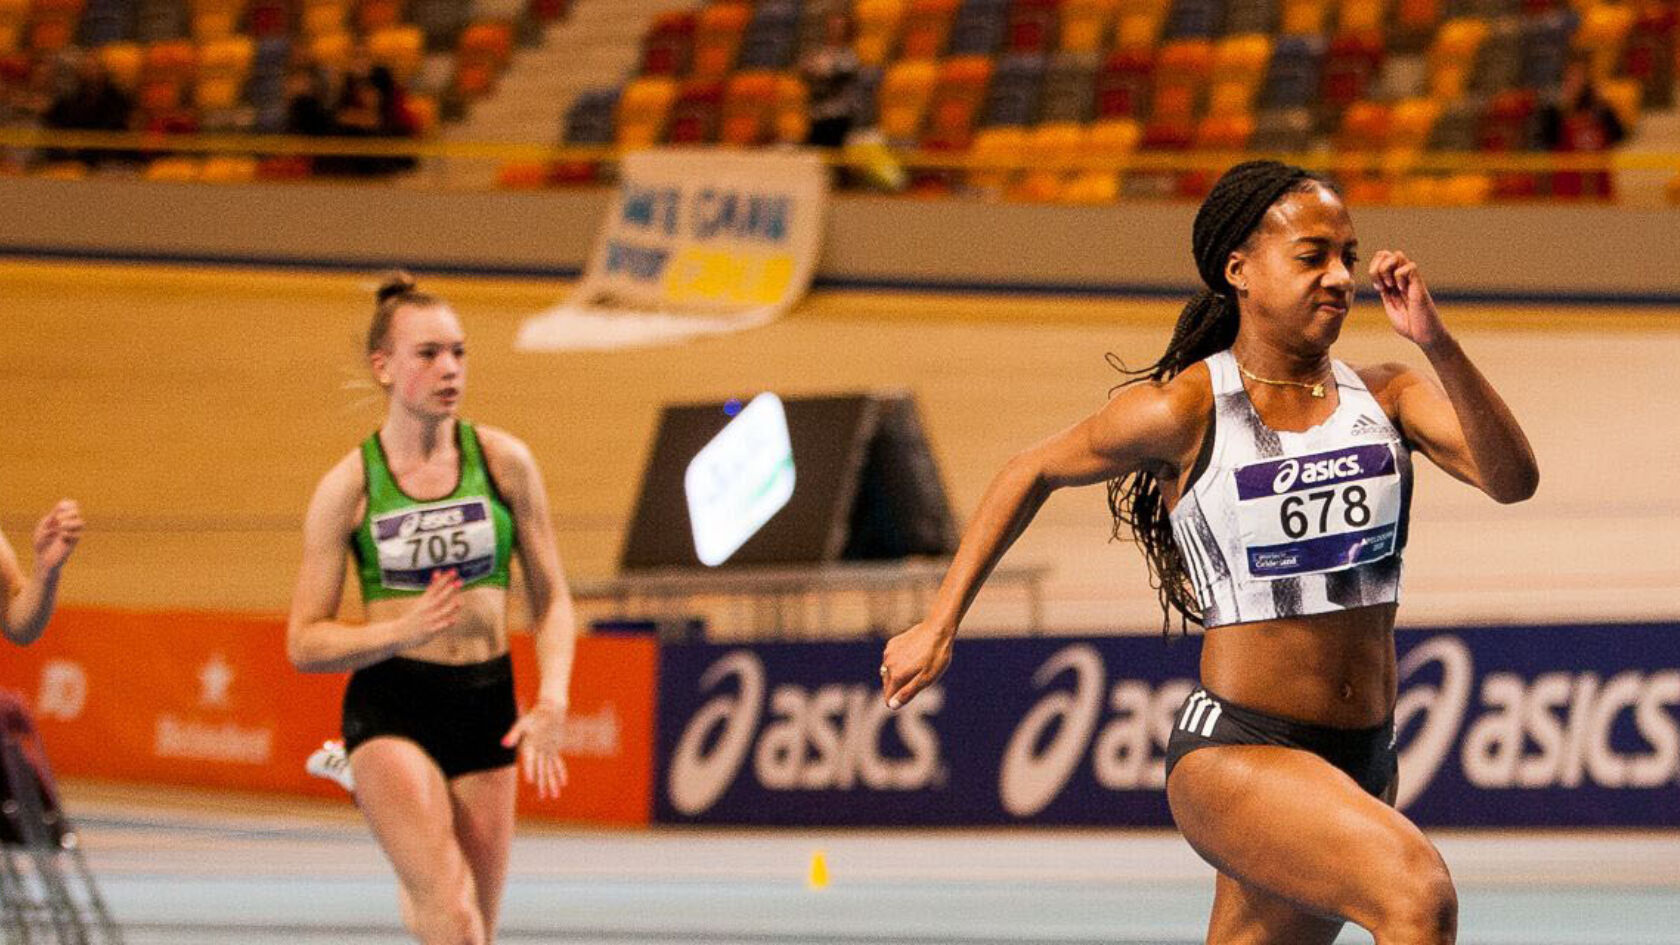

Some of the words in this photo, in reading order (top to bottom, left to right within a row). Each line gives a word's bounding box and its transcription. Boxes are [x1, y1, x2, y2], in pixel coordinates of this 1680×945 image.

[1301, 454, 1361, 484] asics
[1280, 485, 1371, 539] 678
[406, 530, 471, 569] 705
[753, 683, 944, 790] asics
[1461, 669, 1680, 789] asics
